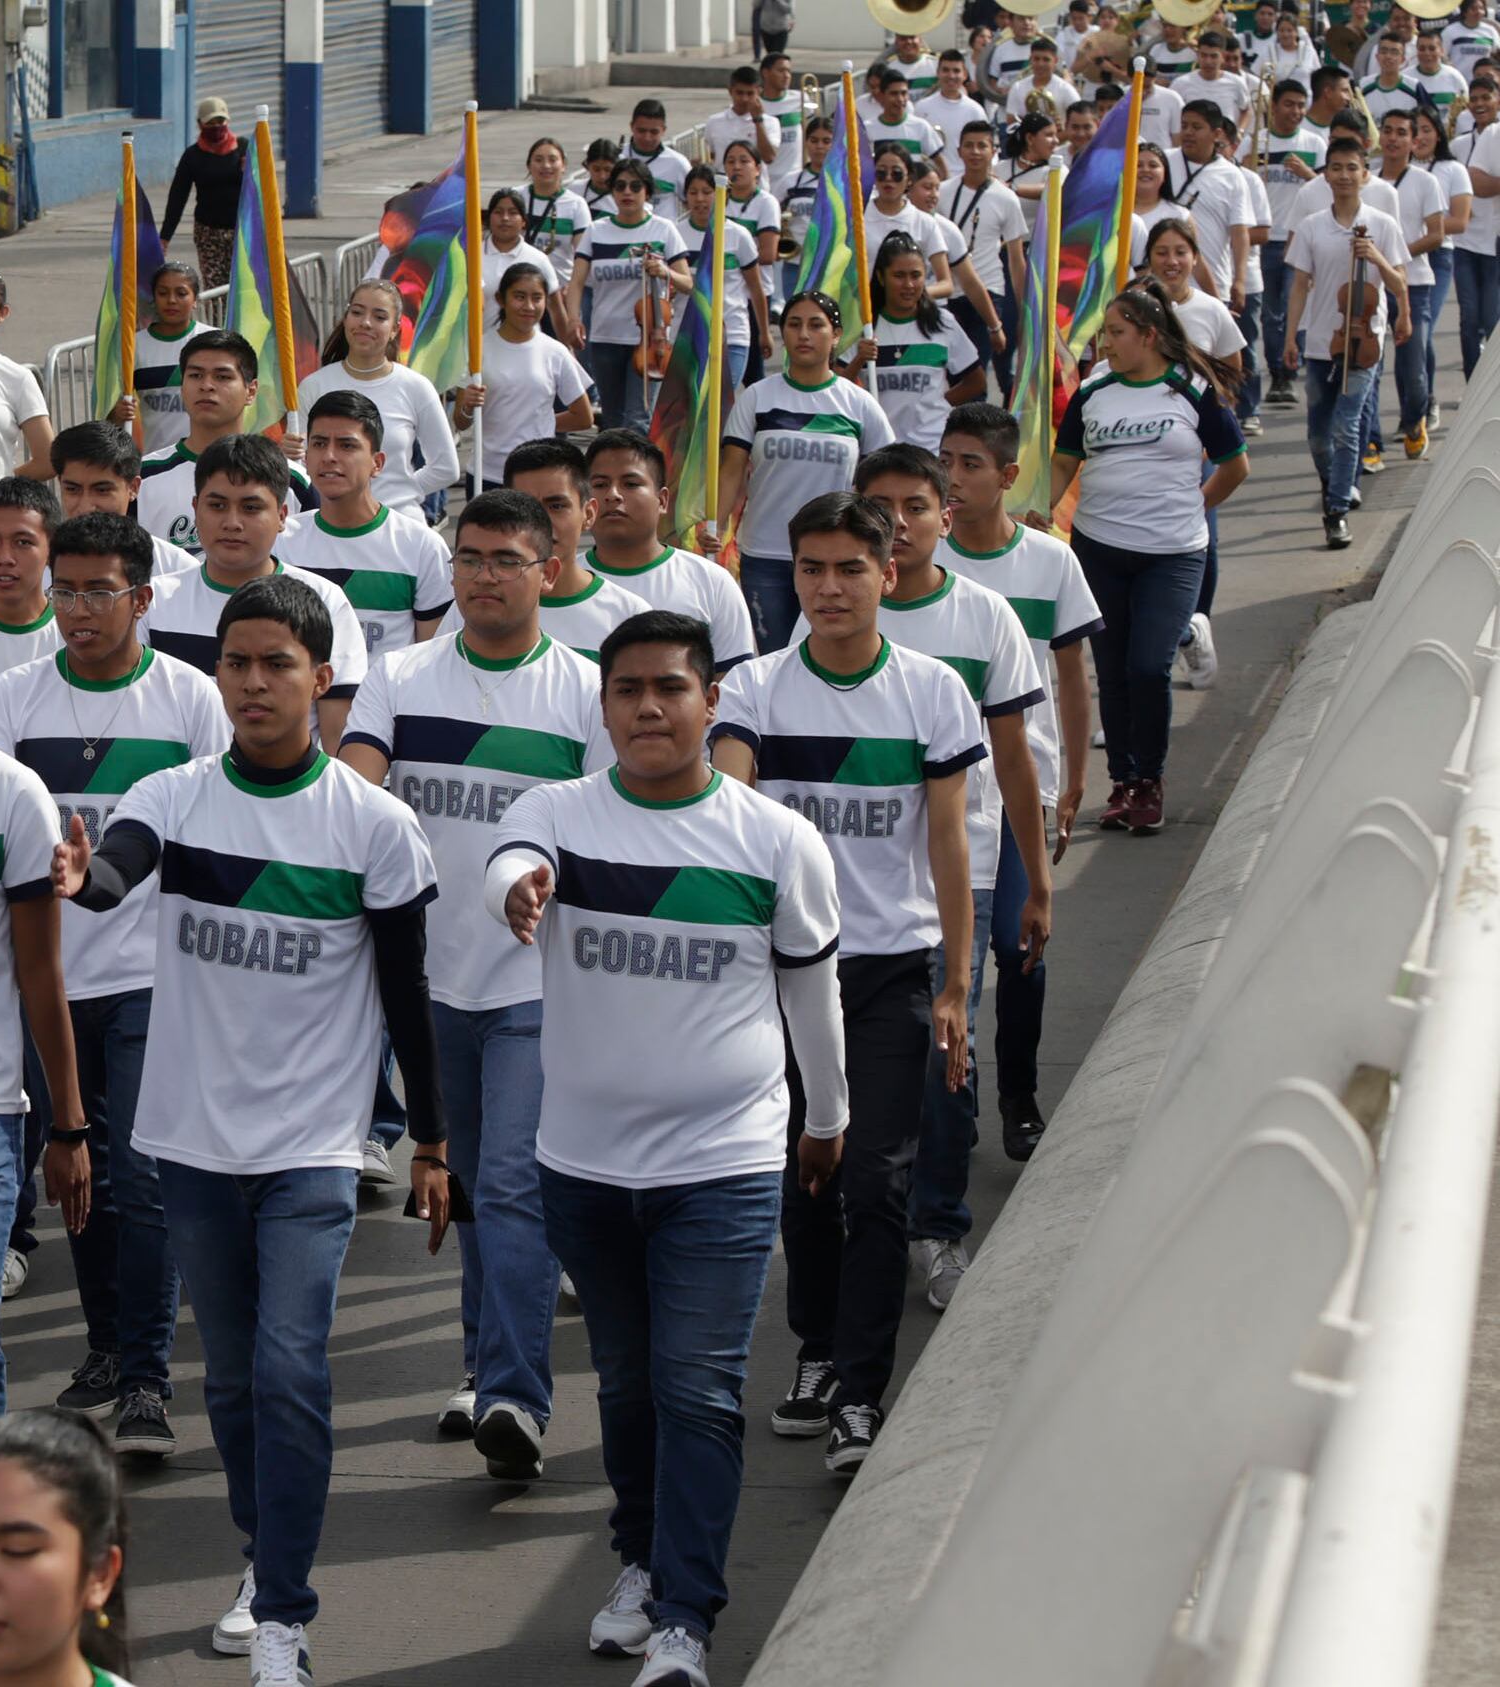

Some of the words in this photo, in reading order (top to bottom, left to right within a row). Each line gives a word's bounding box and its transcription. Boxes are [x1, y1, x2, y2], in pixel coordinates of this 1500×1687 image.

[594, 264, 644, 281] COBAE
[875, 372, 931, 393] OBAEP
[1085, 417, 1175, 444] Cobaep
[763, 436, 850, 466] COBAEP
[402, 774, 527, 824] COBAE
[178, 911, 323, 976] COBAEP
[573, 926, 739, 983] COBAEP
